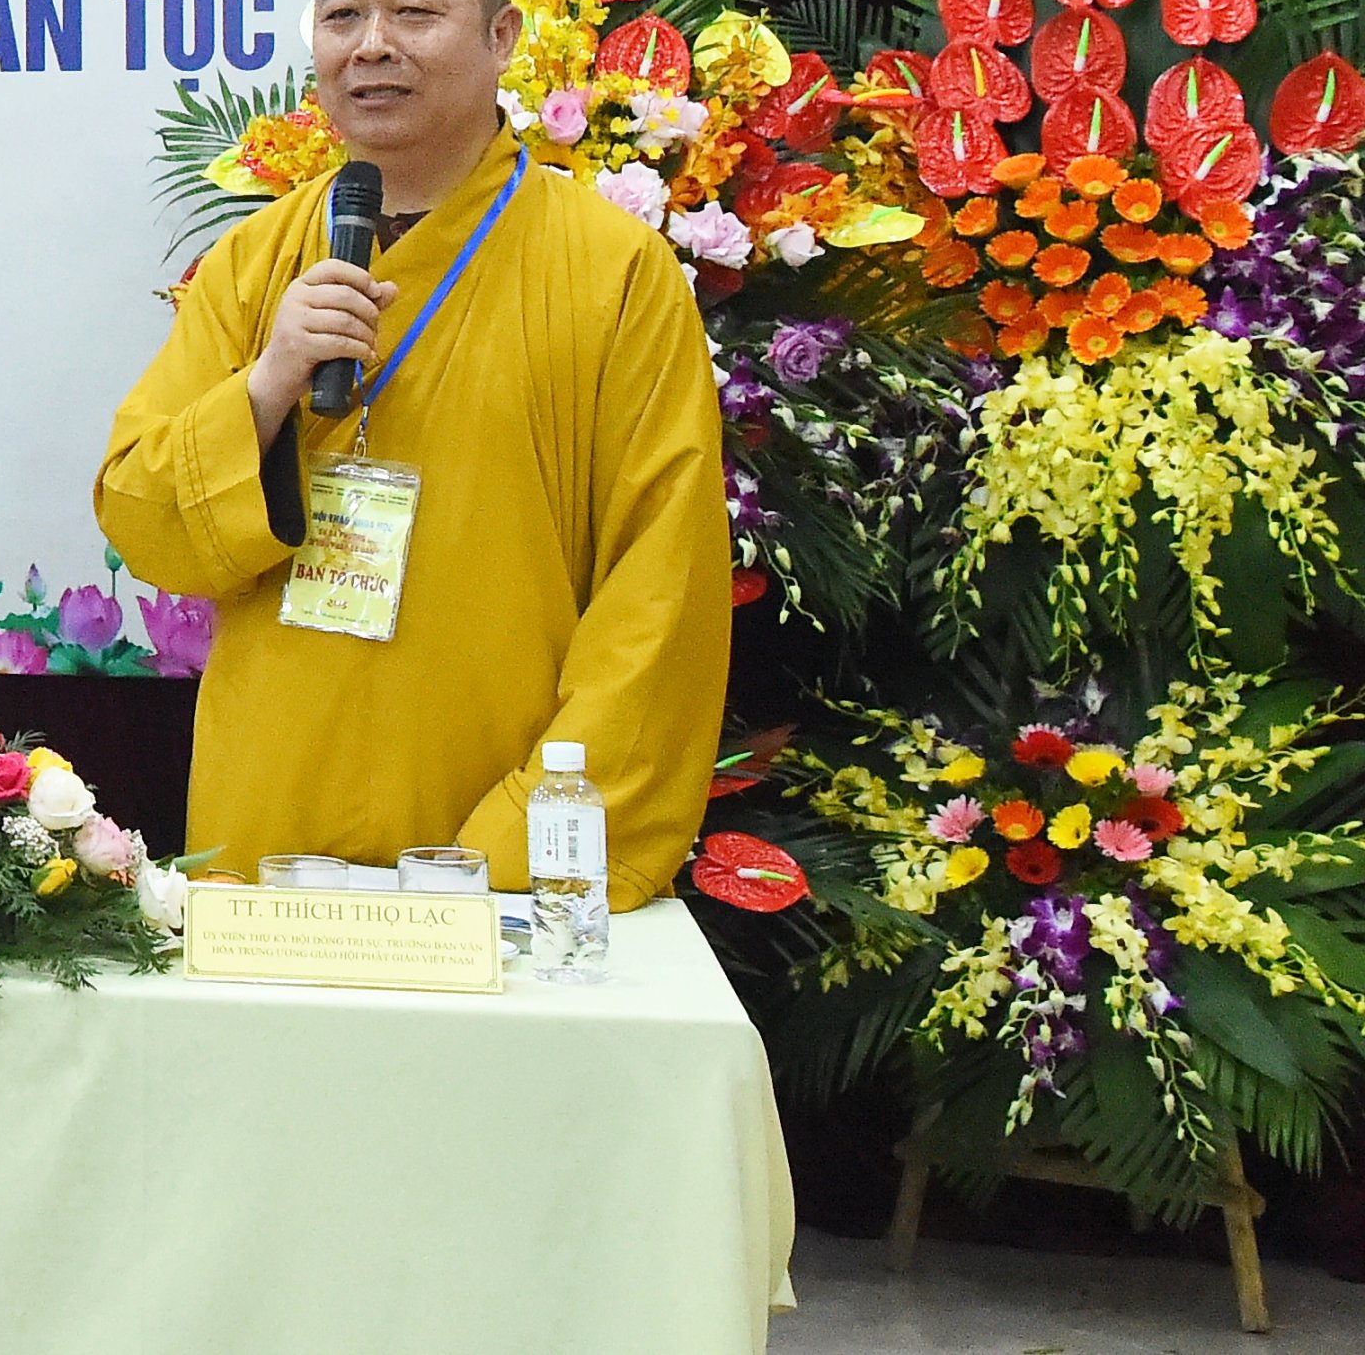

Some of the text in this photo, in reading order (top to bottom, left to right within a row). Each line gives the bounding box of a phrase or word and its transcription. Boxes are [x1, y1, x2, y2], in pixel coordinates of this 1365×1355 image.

[295, 562, 389, 594] BAN TỔ CHỨC
[227, 897, 456, 929] TT. THÍCH THỌ LẠC
